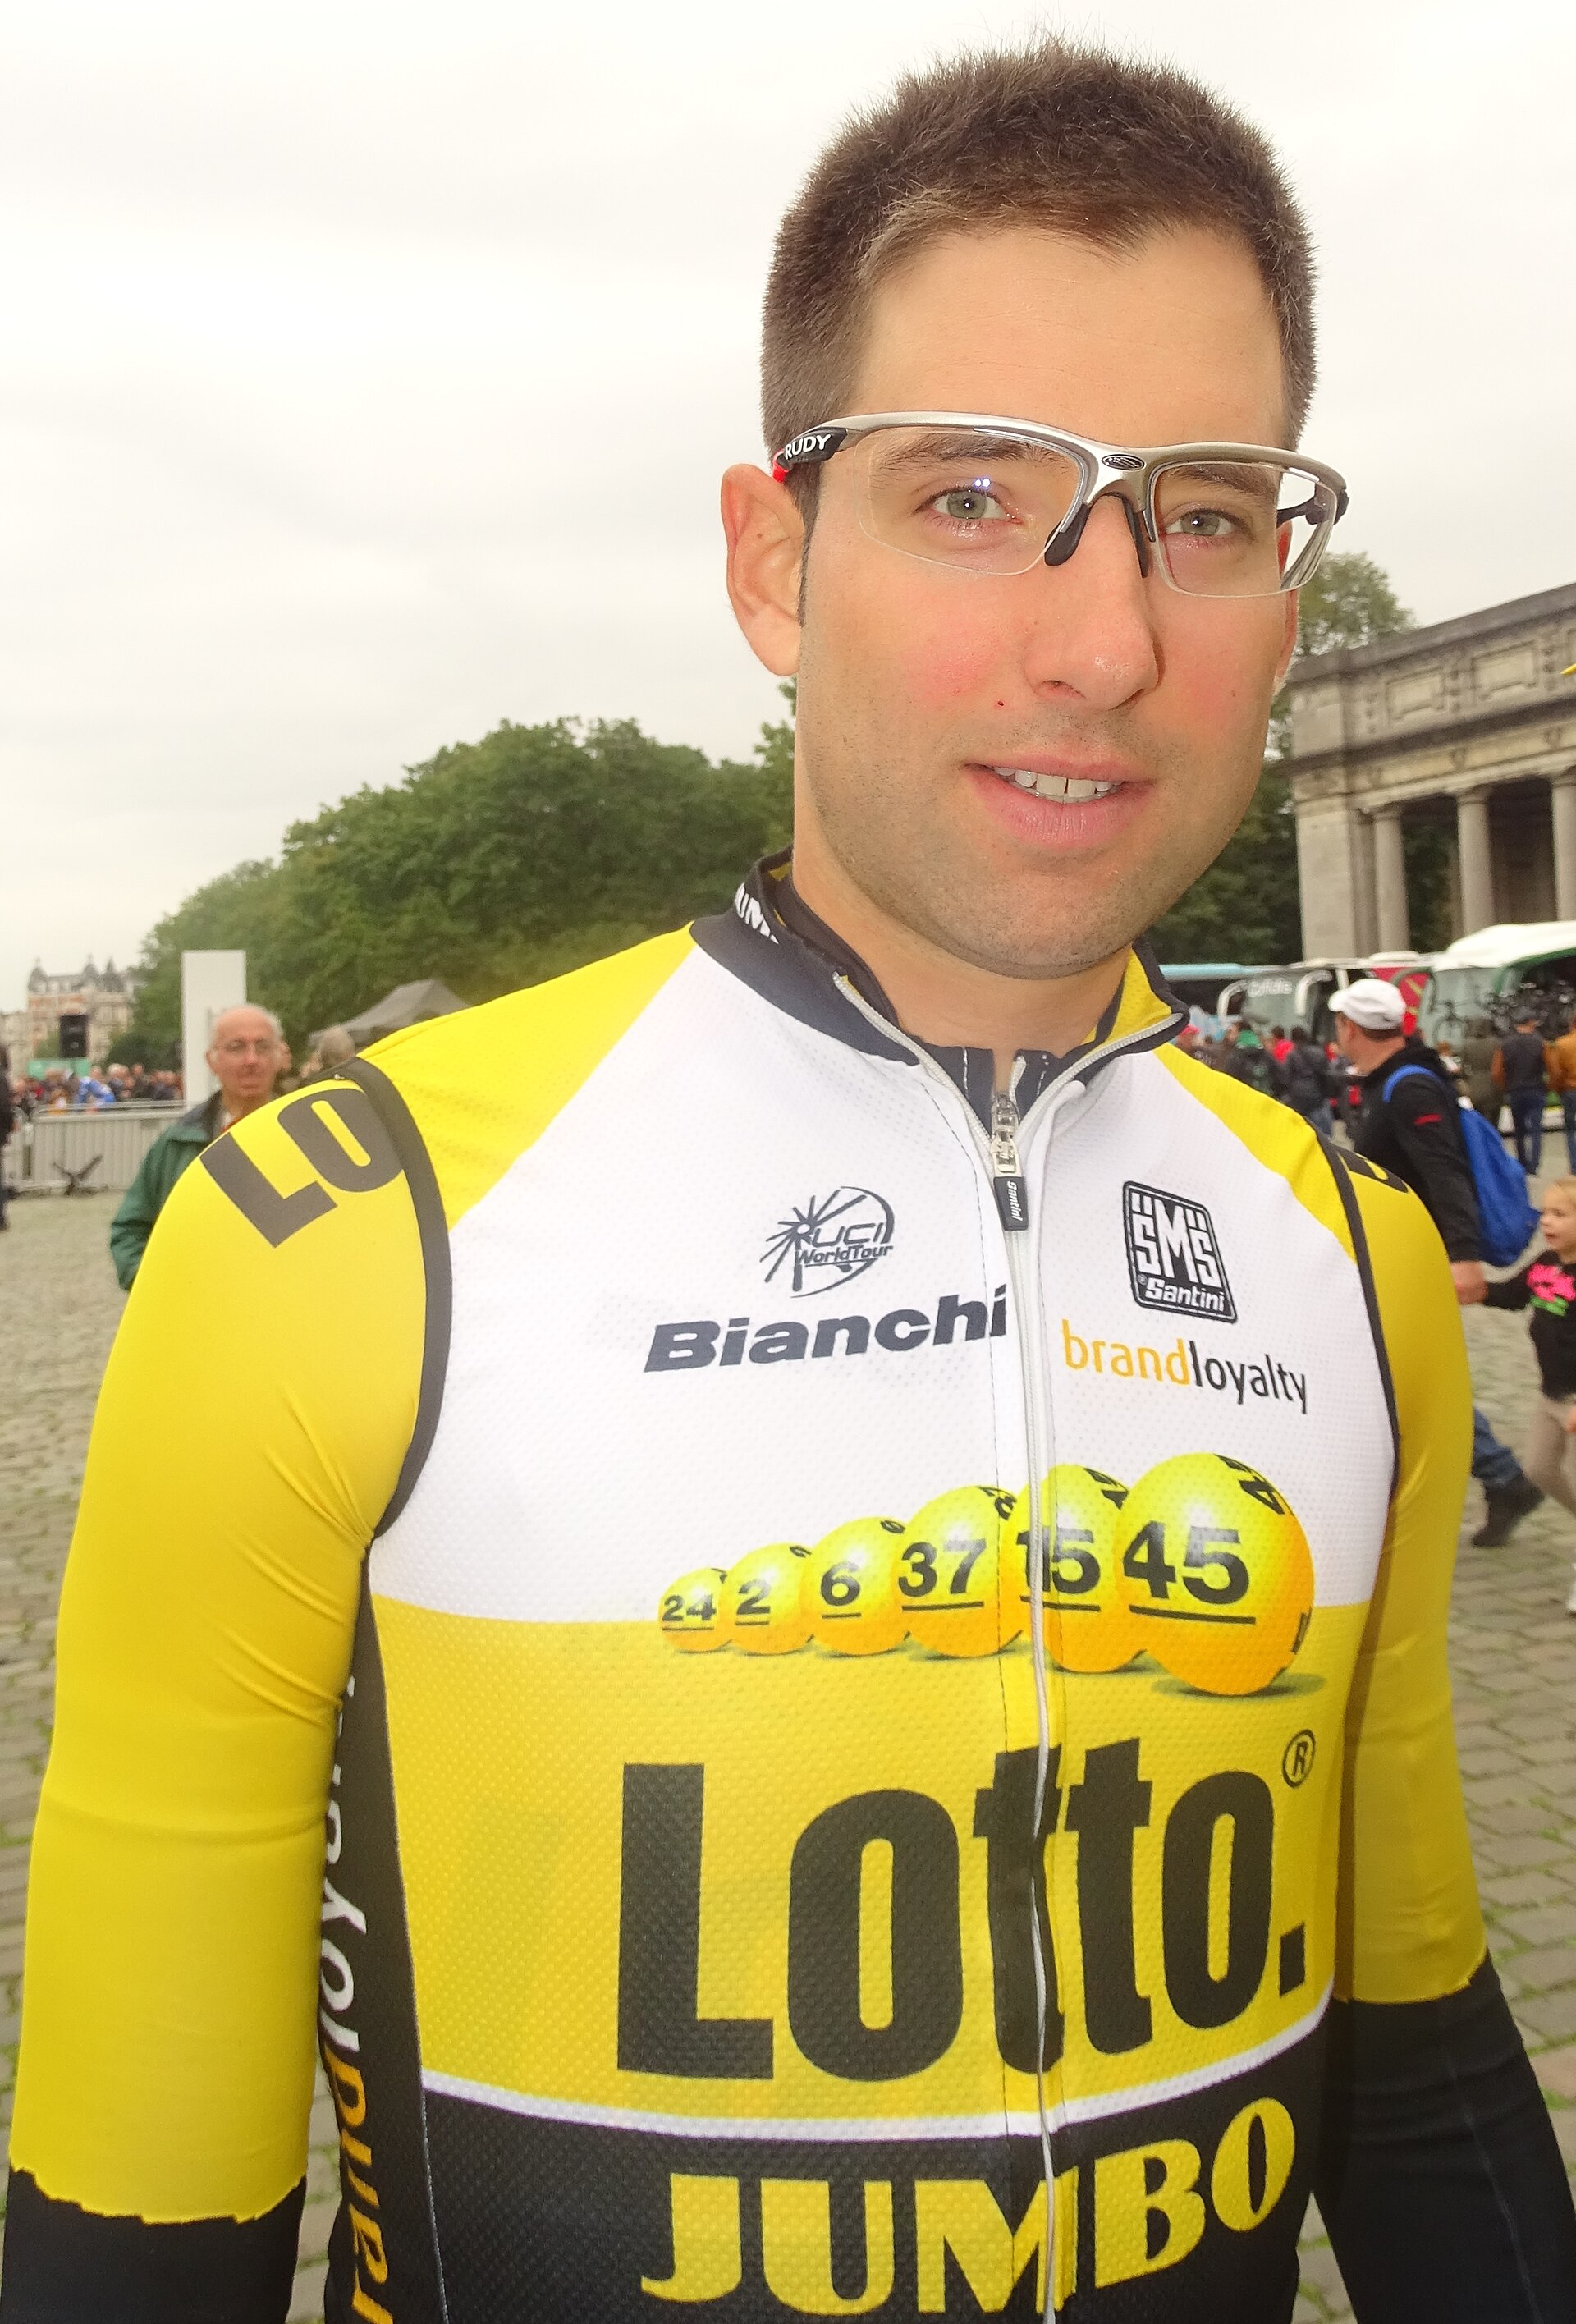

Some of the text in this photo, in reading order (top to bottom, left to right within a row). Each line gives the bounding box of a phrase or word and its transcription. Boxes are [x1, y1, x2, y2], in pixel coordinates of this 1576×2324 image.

[784, 433, 832, 460] RUDY
[798, 1245, 893, 1265] WorldTour
[812, 1222, 885, 1248] UCI
[1130, 1191, 1223, 1289] SMS
[644, 1283, 1007, 1372] Bianchi
[1144, 1277, 1226, 1313] Santini
[1062, 1319, 1308, 1414] brandloyalty
[662, 1520, 1249, 1622] 24 2 6 37 15 45
[641, 2097, 1296, 2316] JUMBO
